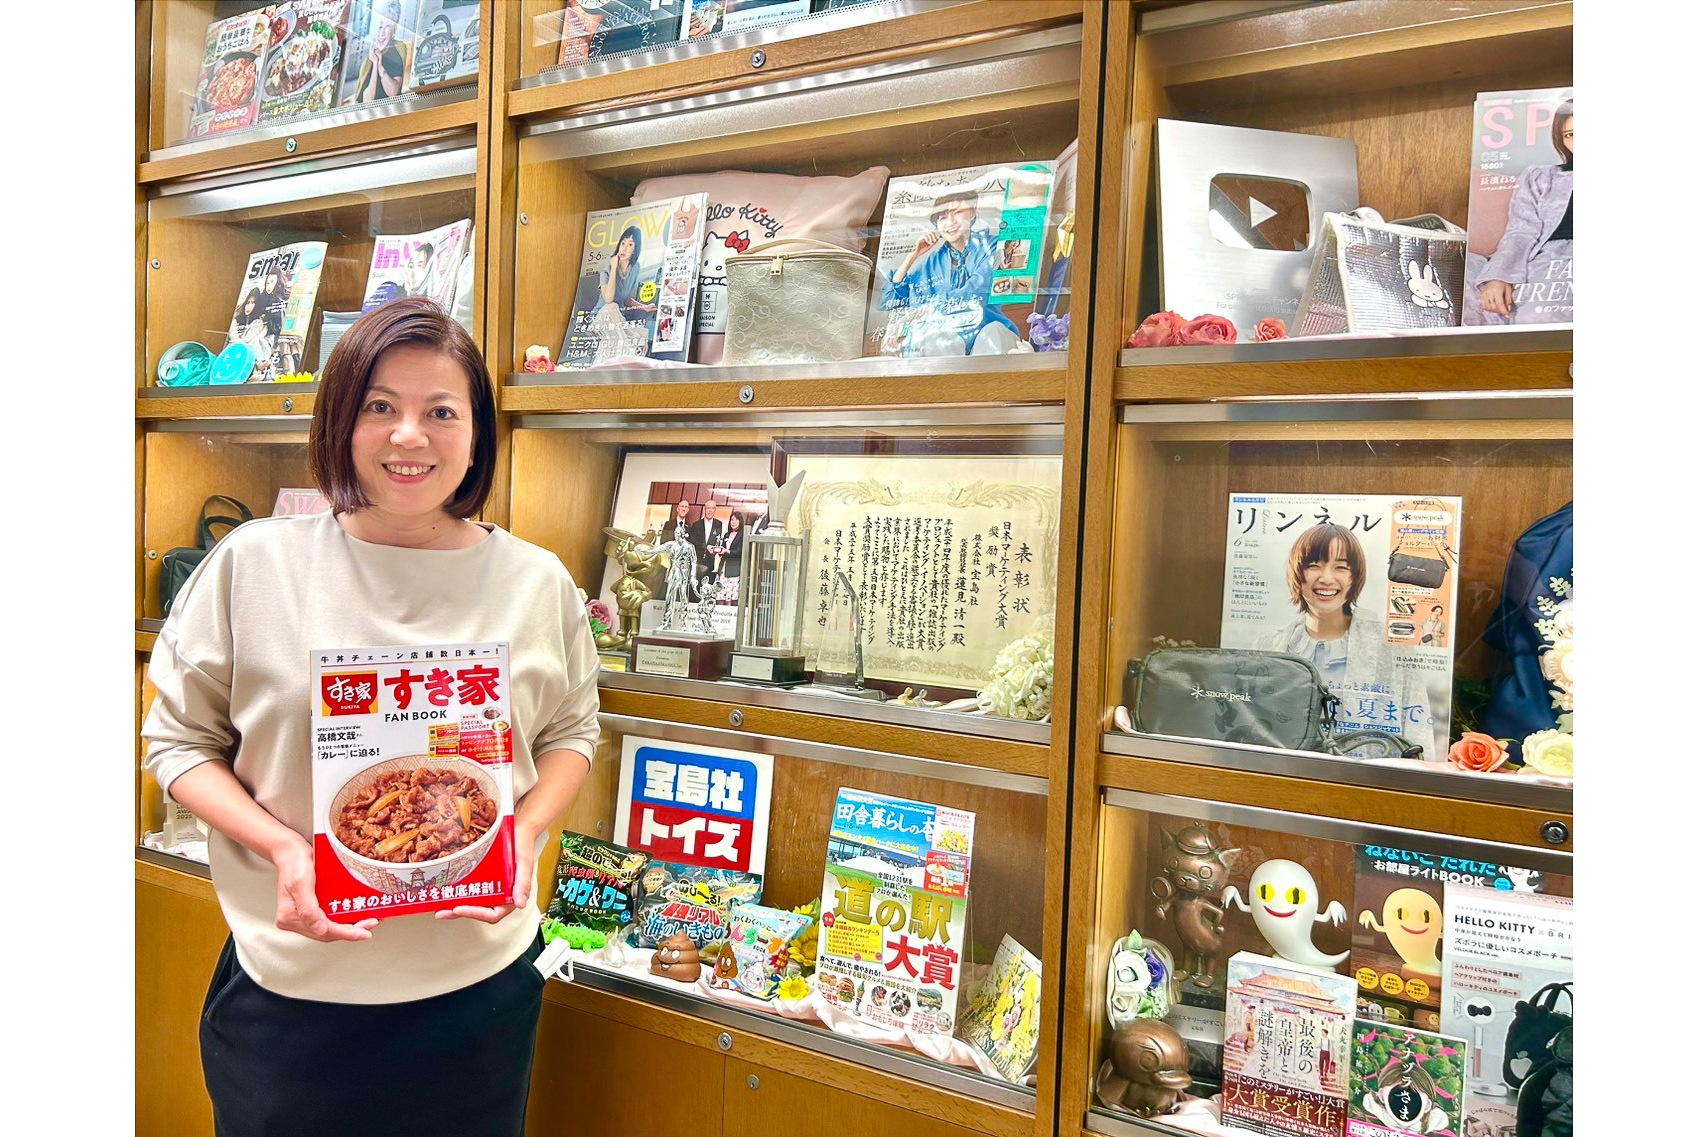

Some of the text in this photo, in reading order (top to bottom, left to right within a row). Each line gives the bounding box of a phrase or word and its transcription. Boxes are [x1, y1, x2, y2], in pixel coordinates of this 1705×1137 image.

[587, 210, 669, 249] GLOW
[739, 202, 784, 239] Kitty
[823, 537, 831, 564] 会長
[985, 525, 1000, 578] 奨励賞
[995, 521, 1013, 631] 日本マーケティング大賞
[1012, 542, 1033, 615] 表彰状
[321, 648, 498, 664] 牛丼チェーン店舗数日本一!
[326, 676, 372, 704] すき家
[383, 664, 500, 710] すき家
[1205, 689, 1252, 702] snow peak
[385, 709, 447, 723] FAN BOOK
[460, 723, 490, 731] PASSPORT
[317, 747, 380, 760] 「カレー」に迫る!
[643, 759, 744, 813] 宝島社
[640, 807, 741, 863] トイズ
[836, 803, 936, 843] 田舎暮らしの本
[877, 871, 914, 885] 全国1231駅を
[1373, 859, 1486, 888] お部屋ライトBOOK
[328, 880, 503, 913] すき家のおいしさを徹底解剖!
[832, 876, 953, 945] 道の駅
[1454, 914, 1495, 929] HELLO
[1498, 920, 1536, 935] KITTY
[883, 934, 960, 991] 大賞
[1473, 949, 1491, 957] BLACK
[1257, 1009, 1274, 1080] 謎解きを
[1278, 1018, 1294, 1074] 皇帝と
[1298, 1017, 1316, 1075] 最後の
[1399, 1033, 1416, 1121] アナヅラさま
[1228, 1083, 1338, 1128] 大賞受賞作
